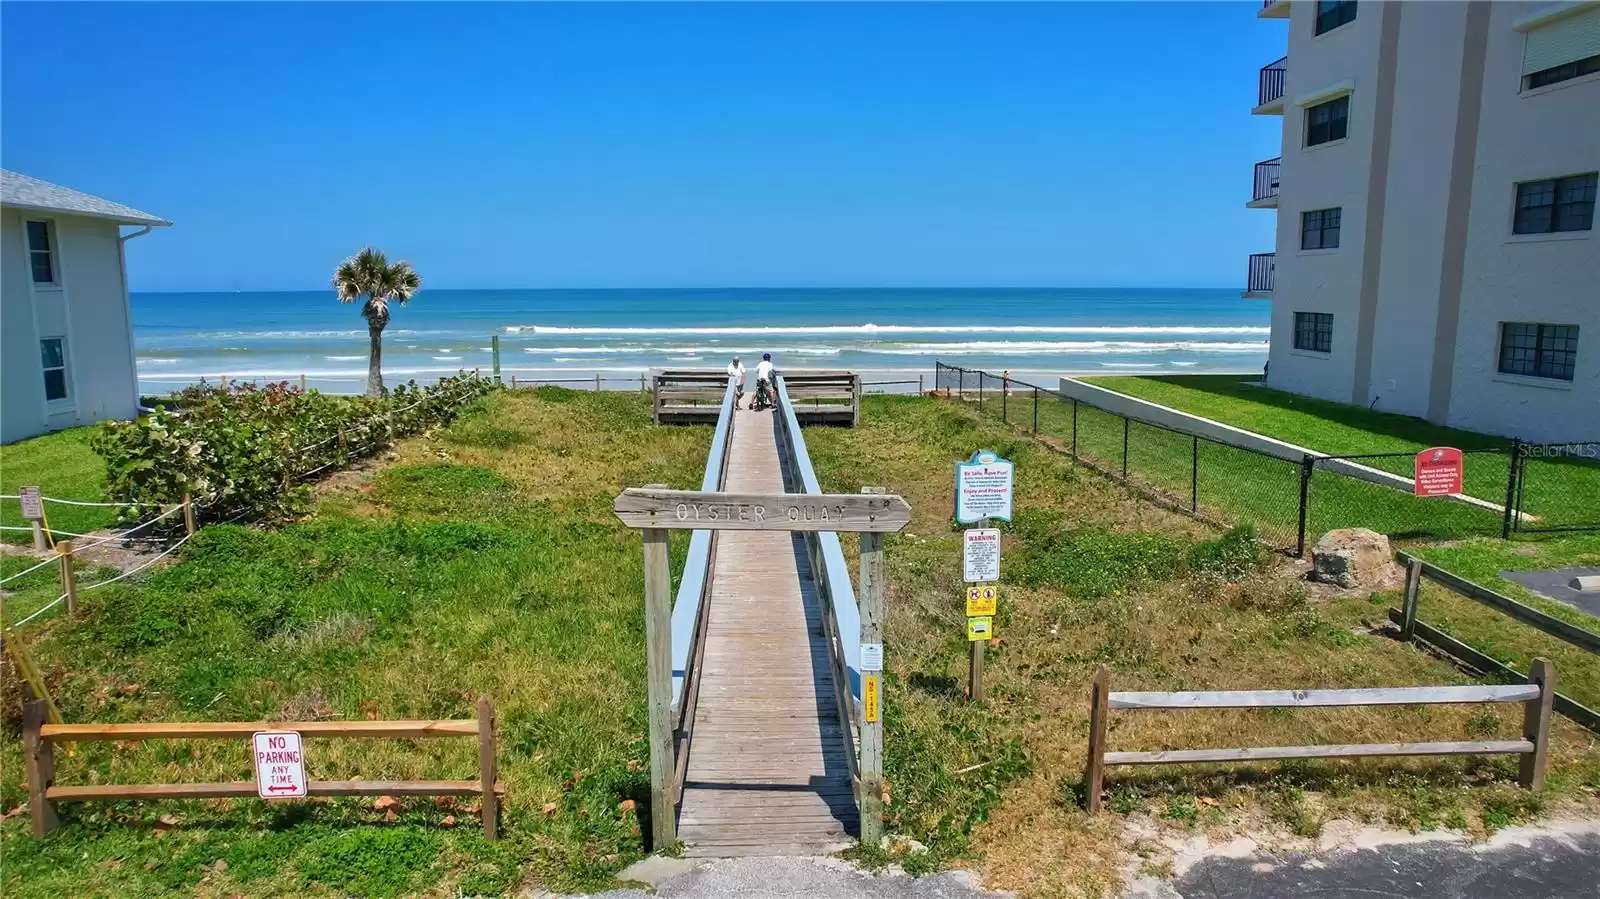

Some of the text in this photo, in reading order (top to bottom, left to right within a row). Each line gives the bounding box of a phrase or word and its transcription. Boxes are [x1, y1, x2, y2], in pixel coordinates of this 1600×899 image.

[676, 503, 846, 521] OYSTER QUAY
[268, 736, 286, 749] NO
[259, 751, 299, 763] PARKING
[271, 765, 289, 774] ANY
[271, 775, 293, 783] TIME
